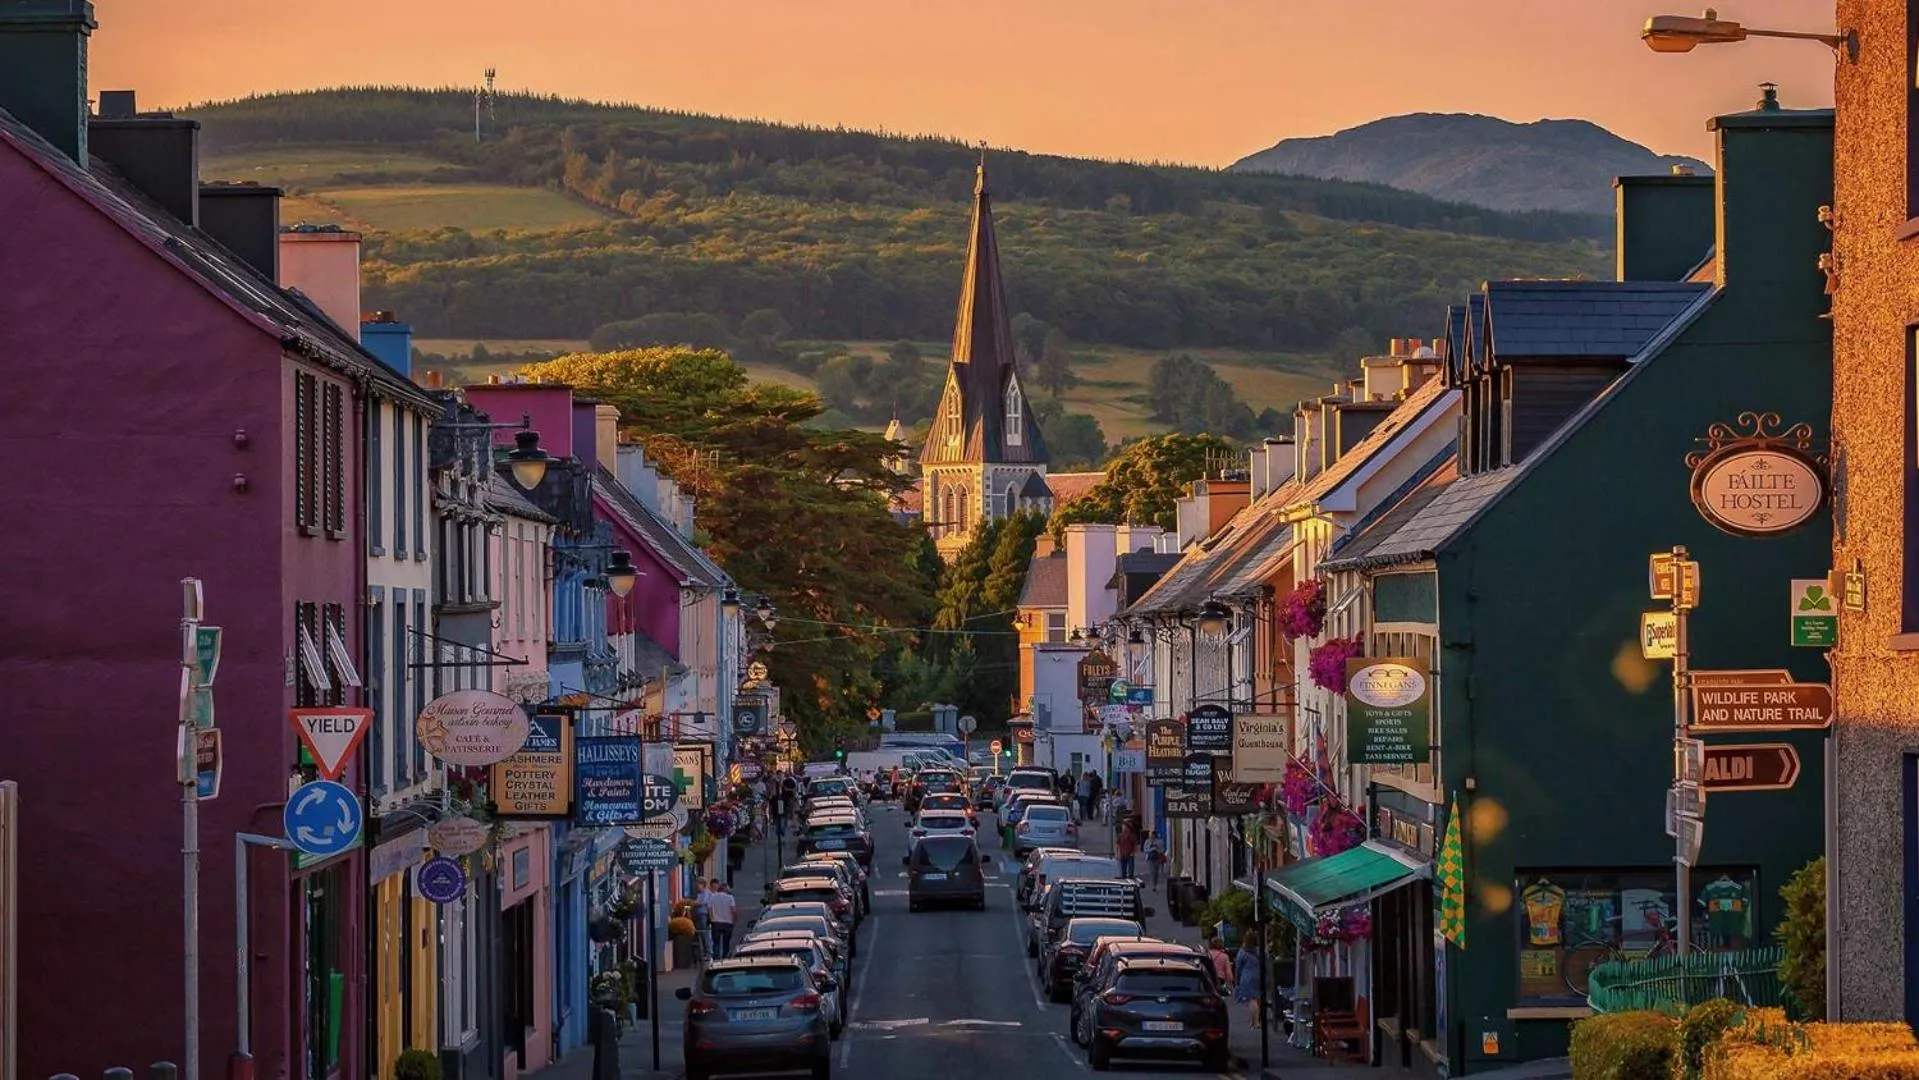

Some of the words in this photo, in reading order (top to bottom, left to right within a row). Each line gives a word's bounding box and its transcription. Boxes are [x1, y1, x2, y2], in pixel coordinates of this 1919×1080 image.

[1727, 469, 1796, 489] FÁILTE
[1720, 494, 1804, 509] HOSTEL
[1702, 692, 1759, 704] WILDLIFE
[1763, 691, 1797, 704] PARK
[1702, 709, 1729, 721] AND
[1734, 708, 1783, 721] NATURE
[1787, 707, 1824, 720] TRAIL
[306, 718, 356, 733] YIELD
[1239, 721, 1285, 735] Virginia's
[482, 735, 490, 743] &
[1238, 738, 1284, 749] Guesthouse
[1704, 756, 1754, 781] ALDI
[505, 770, 557, 779] POTTERY
[505, 781, 556, 790] CRYSTAL
[505, 791, 556, 801] LEATHER
[645, 786, 671, 797] ITE
[514, 802, 547, 811] GIFTS
[1167, 802, 1198, 812] BAR
[596, 810, 622, 822] Gifts
